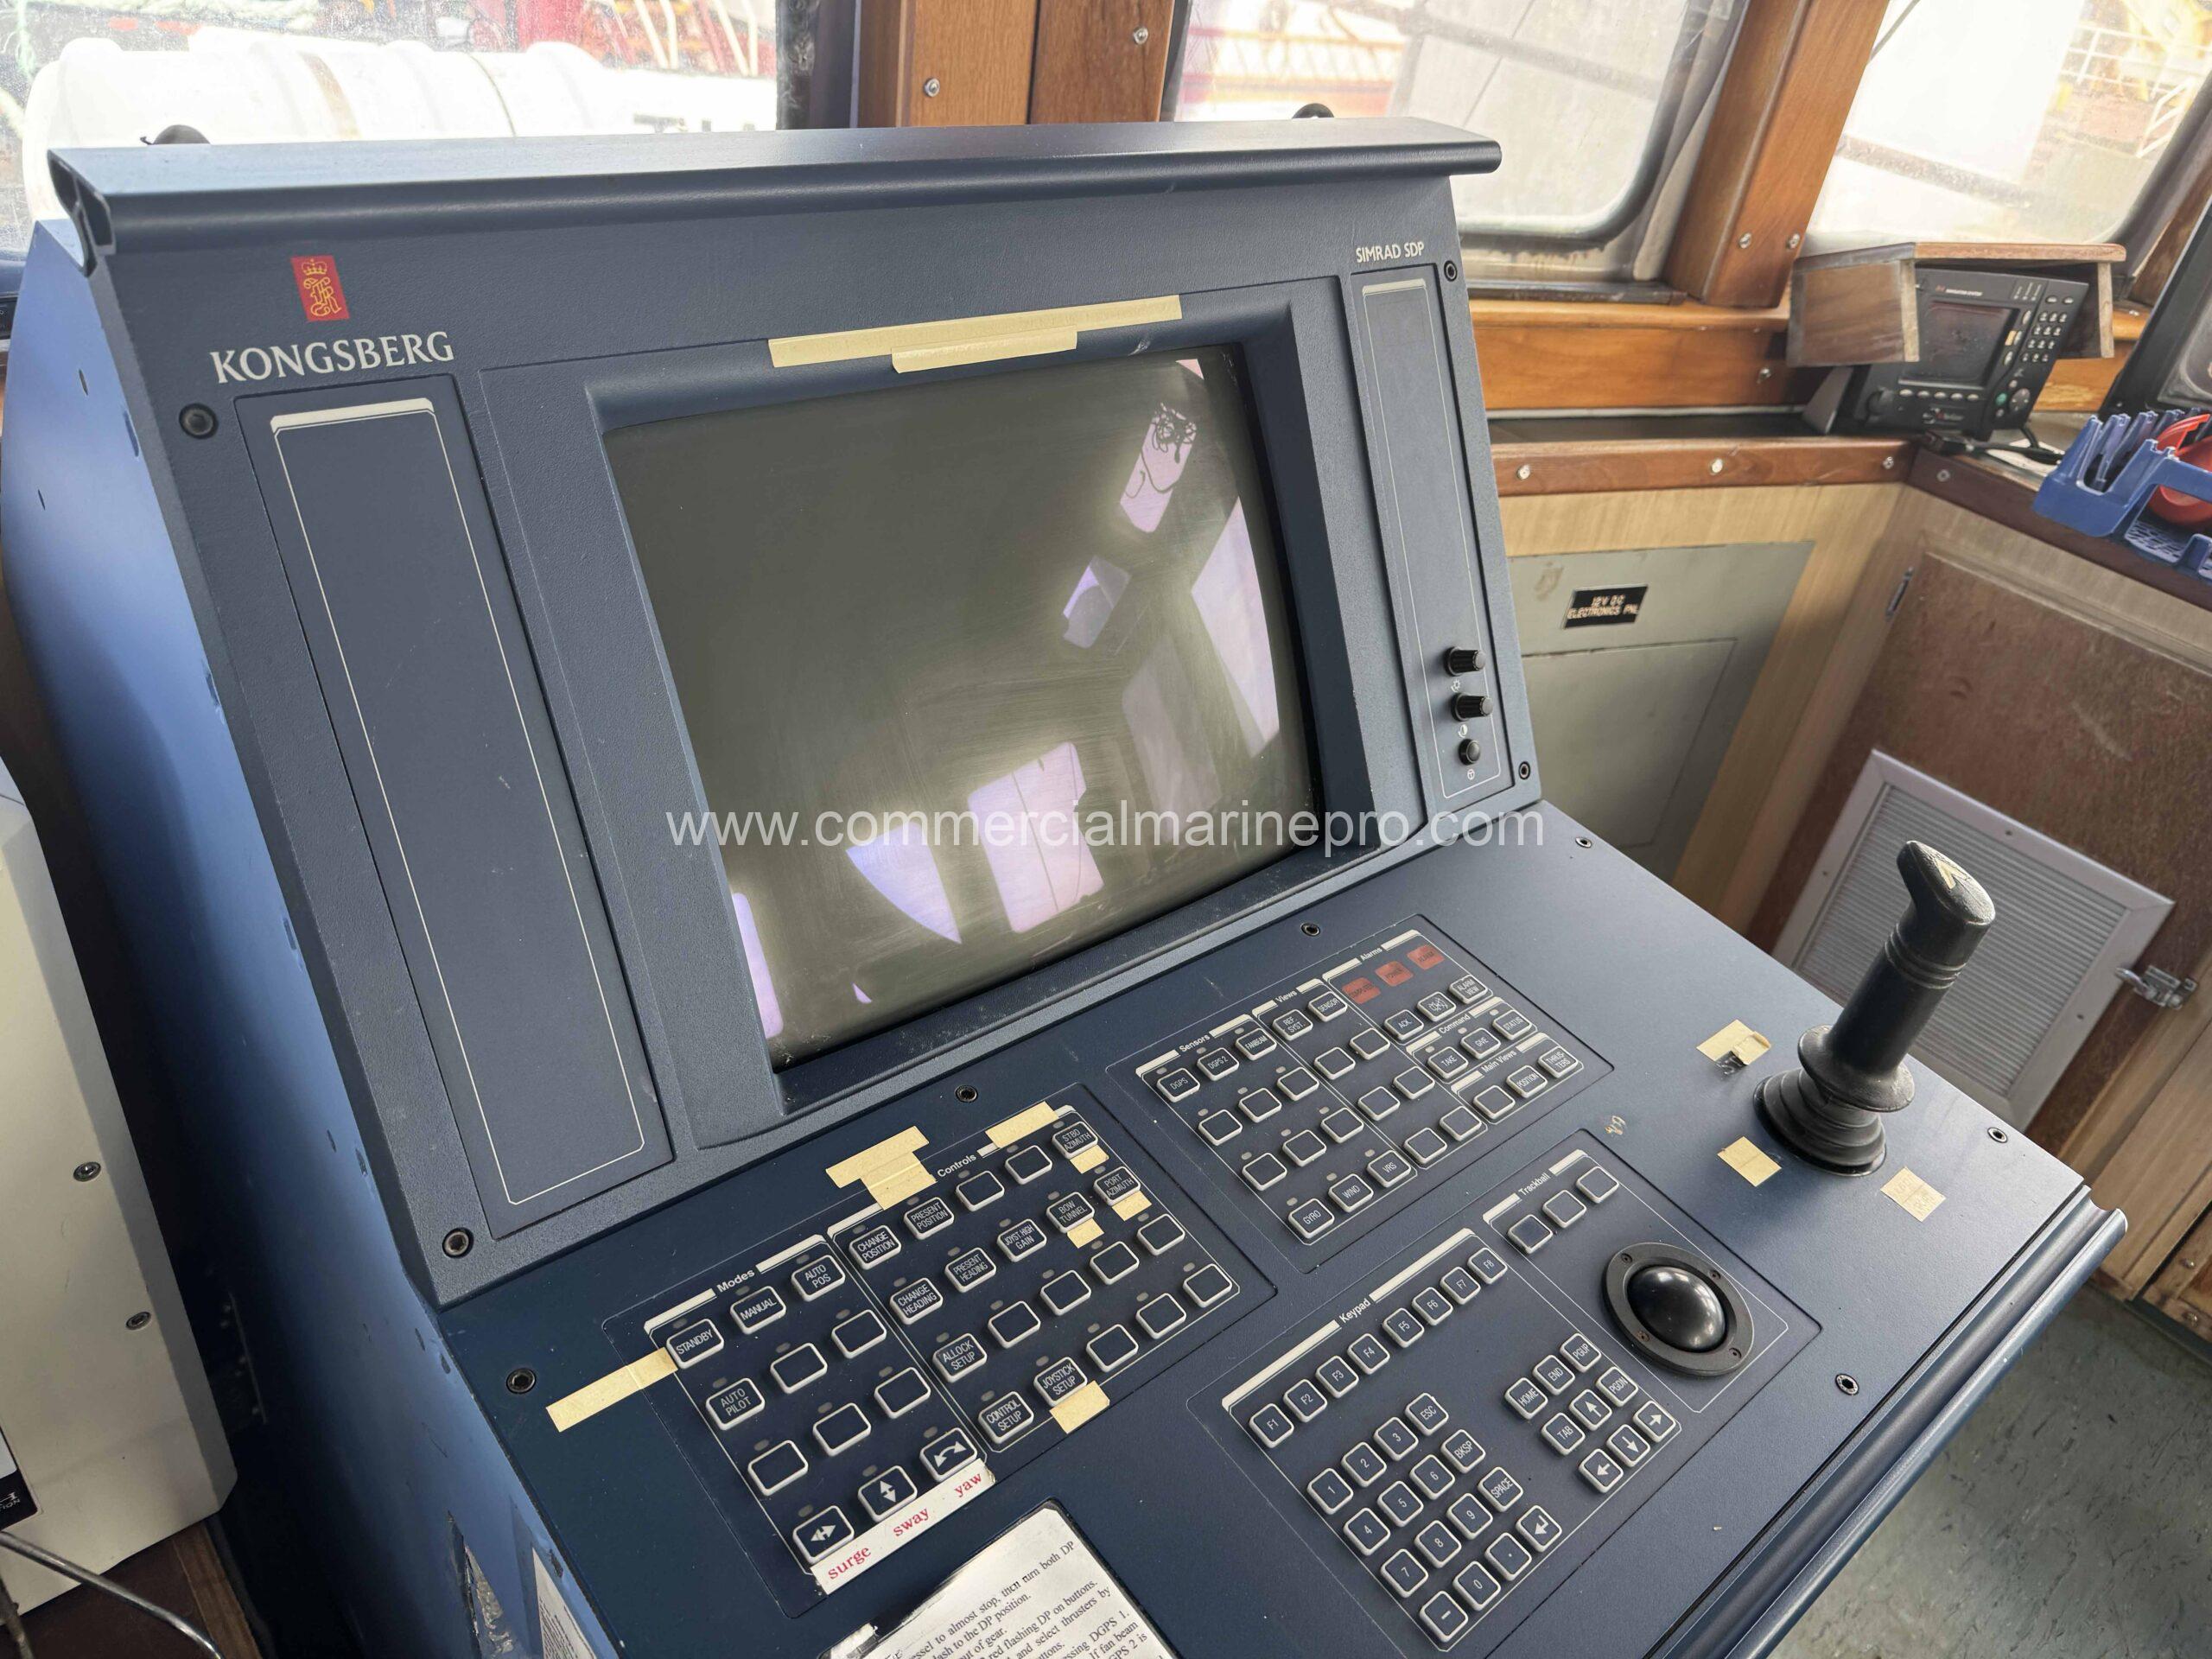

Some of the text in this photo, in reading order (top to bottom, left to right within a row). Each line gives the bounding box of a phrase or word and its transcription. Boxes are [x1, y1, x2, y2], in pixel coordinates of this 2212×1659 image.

[1356, 241, 1425, 263] SIMRAD SDP
[209, 331, 454, 384] KONGSBERG
[1567, 605, 1621, 620] ELECTRONICS
[1360, 947, 1383, 962] Alarms
[1276, 990, 1298, 1004] Views
[1318, 998, 1339, 1013] SENSOR
[1398, 1019, 1412, 1029] ACK
[1439, 1014, 1471, 1034] Command
[1503, 1016, 1524, 1031] STATUS
[1179, 1033, 1211, 1053] Sensors
[1474, 1036, 1489, 1047] GIVE
[1208, 1057, 1224, 1071] DGPS
[1440, 1054, 1459, 1067] TAKE
[1481, 1050, 1517, 1072] Main Views
[1169, 1077, 1189, 1090] DGPS
[1516, 1072, 1539, 1088] POSITION
[1062, 1128, 1081, 1142] STBD
[1064, 1132, 1092, 1152] AZIMUTH
[937, 1154, 977, 1178] Controls
[1382, 1161, 1397, 1173] VRS
[1104, 1173, 1123, 1188] PORT
[1106, 1177, 1134, 1198] AZIMUTH
[1518, 1173, 1551, 1196] Trackball
[1342, 1185, 1361, 1199] WIND
[910, 1202, 942, 1223] PRESENT
[1058, 1200, 1075, 1214] BOW
[1059, 1205, 1089, 1224] TUNNEL
[918, 1210, 949, 1230] POSITION
[1302, 1210, 1321, 1225] GYRO
[857, 1230, 889, 1252] CHANGE
[1015, 1234, 1035, 1250] GAIN
[861, 1239, 896, 1262] POSITION
[804, 1263, 827, 1281] AUTO
[952, 1254, 982, 1274] PRESENT
[959, 1262, 988, 1283] HEADING
[1483, 1259, 1494, 1271] F8
[716, 1269, 755, 1294] Modes
[812, 1274, 831, 1289] POS
[1456, 1279, 1467, 1291] F7
[898, 1284, 931, 1307] CHANGE
[903, 1293, 938, 1315] HEADING
[740, 1298, 778, 1320] MANUAL
[1339, 1298, 1371, 1325] Keypad
[1427, 1299, 1439, 1311] F6
[1398, 1319, 1410, 1332] F5
[675, 1328, 714, 1356] STANDBY
[943, 1340, 975, 1363] ALLOCK
[1363, 1346, 1376, 1359] F4
[1572, 1343, 1591, 1361] PGUP
[950, 1351, 976, 1371] SETUP
[1042, 1363, 1076, 1389] JOYSTICK
[1332, 1370, 1344, 1382] F3
[1548, 1367, 1564, 1382] END
[1052, 1376, 1077, 1396] SETUP
[1609, 1376, 1629, 1395] PGDN
[720, 1388, 747, 1408] AUTO
[725, 1395, 753, 1417] PILOT
[1300, 1393, 1313, 1406] F2
[1517, 1387, 1540, 1408] HOME
[986, 1399, 1021, 1424] CONTROL
[1420, 1404, 1437, 1421] ESC
[997, 1410, 1023, 1432] SETUP
[1267, 1418, 1279, 1432] F1
[1393, 1433, 1402, 1442] 3
[1556, 1425, 1574, 1441] TAB
[1453, 1440, 1474, 1460] BKSP
[1360, 1458, 1370, 1469] 2
[1430, 1471, 1440, 1481] 6
[1327, 1484, 1336, 1495] 1
[1491, 1477, 1514, 1499] SPACE
[1398, 1497, 1408, 1509] 5
[1466, 1510, 1476, 1521] 9
[828, 1471, 983, 1580] surge sway yaw
[1363, 1524, 1373, 1535] 4
[1433, 1537, 1444, 1548] 8
[1400, 1566, 1411, 1579] 7
[935, 1634, 946, 1644] to
[948, 1611, 978, 1636] almost
[1039, 1553, 1061, 1570] both
[1060, 1541, 1075, 1556] DP
[953, 1639, 964, 1649] to
[963, 1628, 980, 1642] the
[977, 1615, 993, 1631] DP
[995, 1595, 1033, 1623] position.
[988, 1580, 1098, 1659] red flashing DP on buttons.
[1016, 1586, 1111, 1659] and select thrusters by
[1090, 1618, 1118, 1643] DGPS
[1099, 1640, 1116, 1654] fan
[1113, 1621, 1139, 1642] beam
[974, 1639, 985, 1653] of
[985, 1628, 1008, 1648] gear.
[1128, 1639, 1138, 1649] 2
[1136, 1633, 1147, 1643] is
